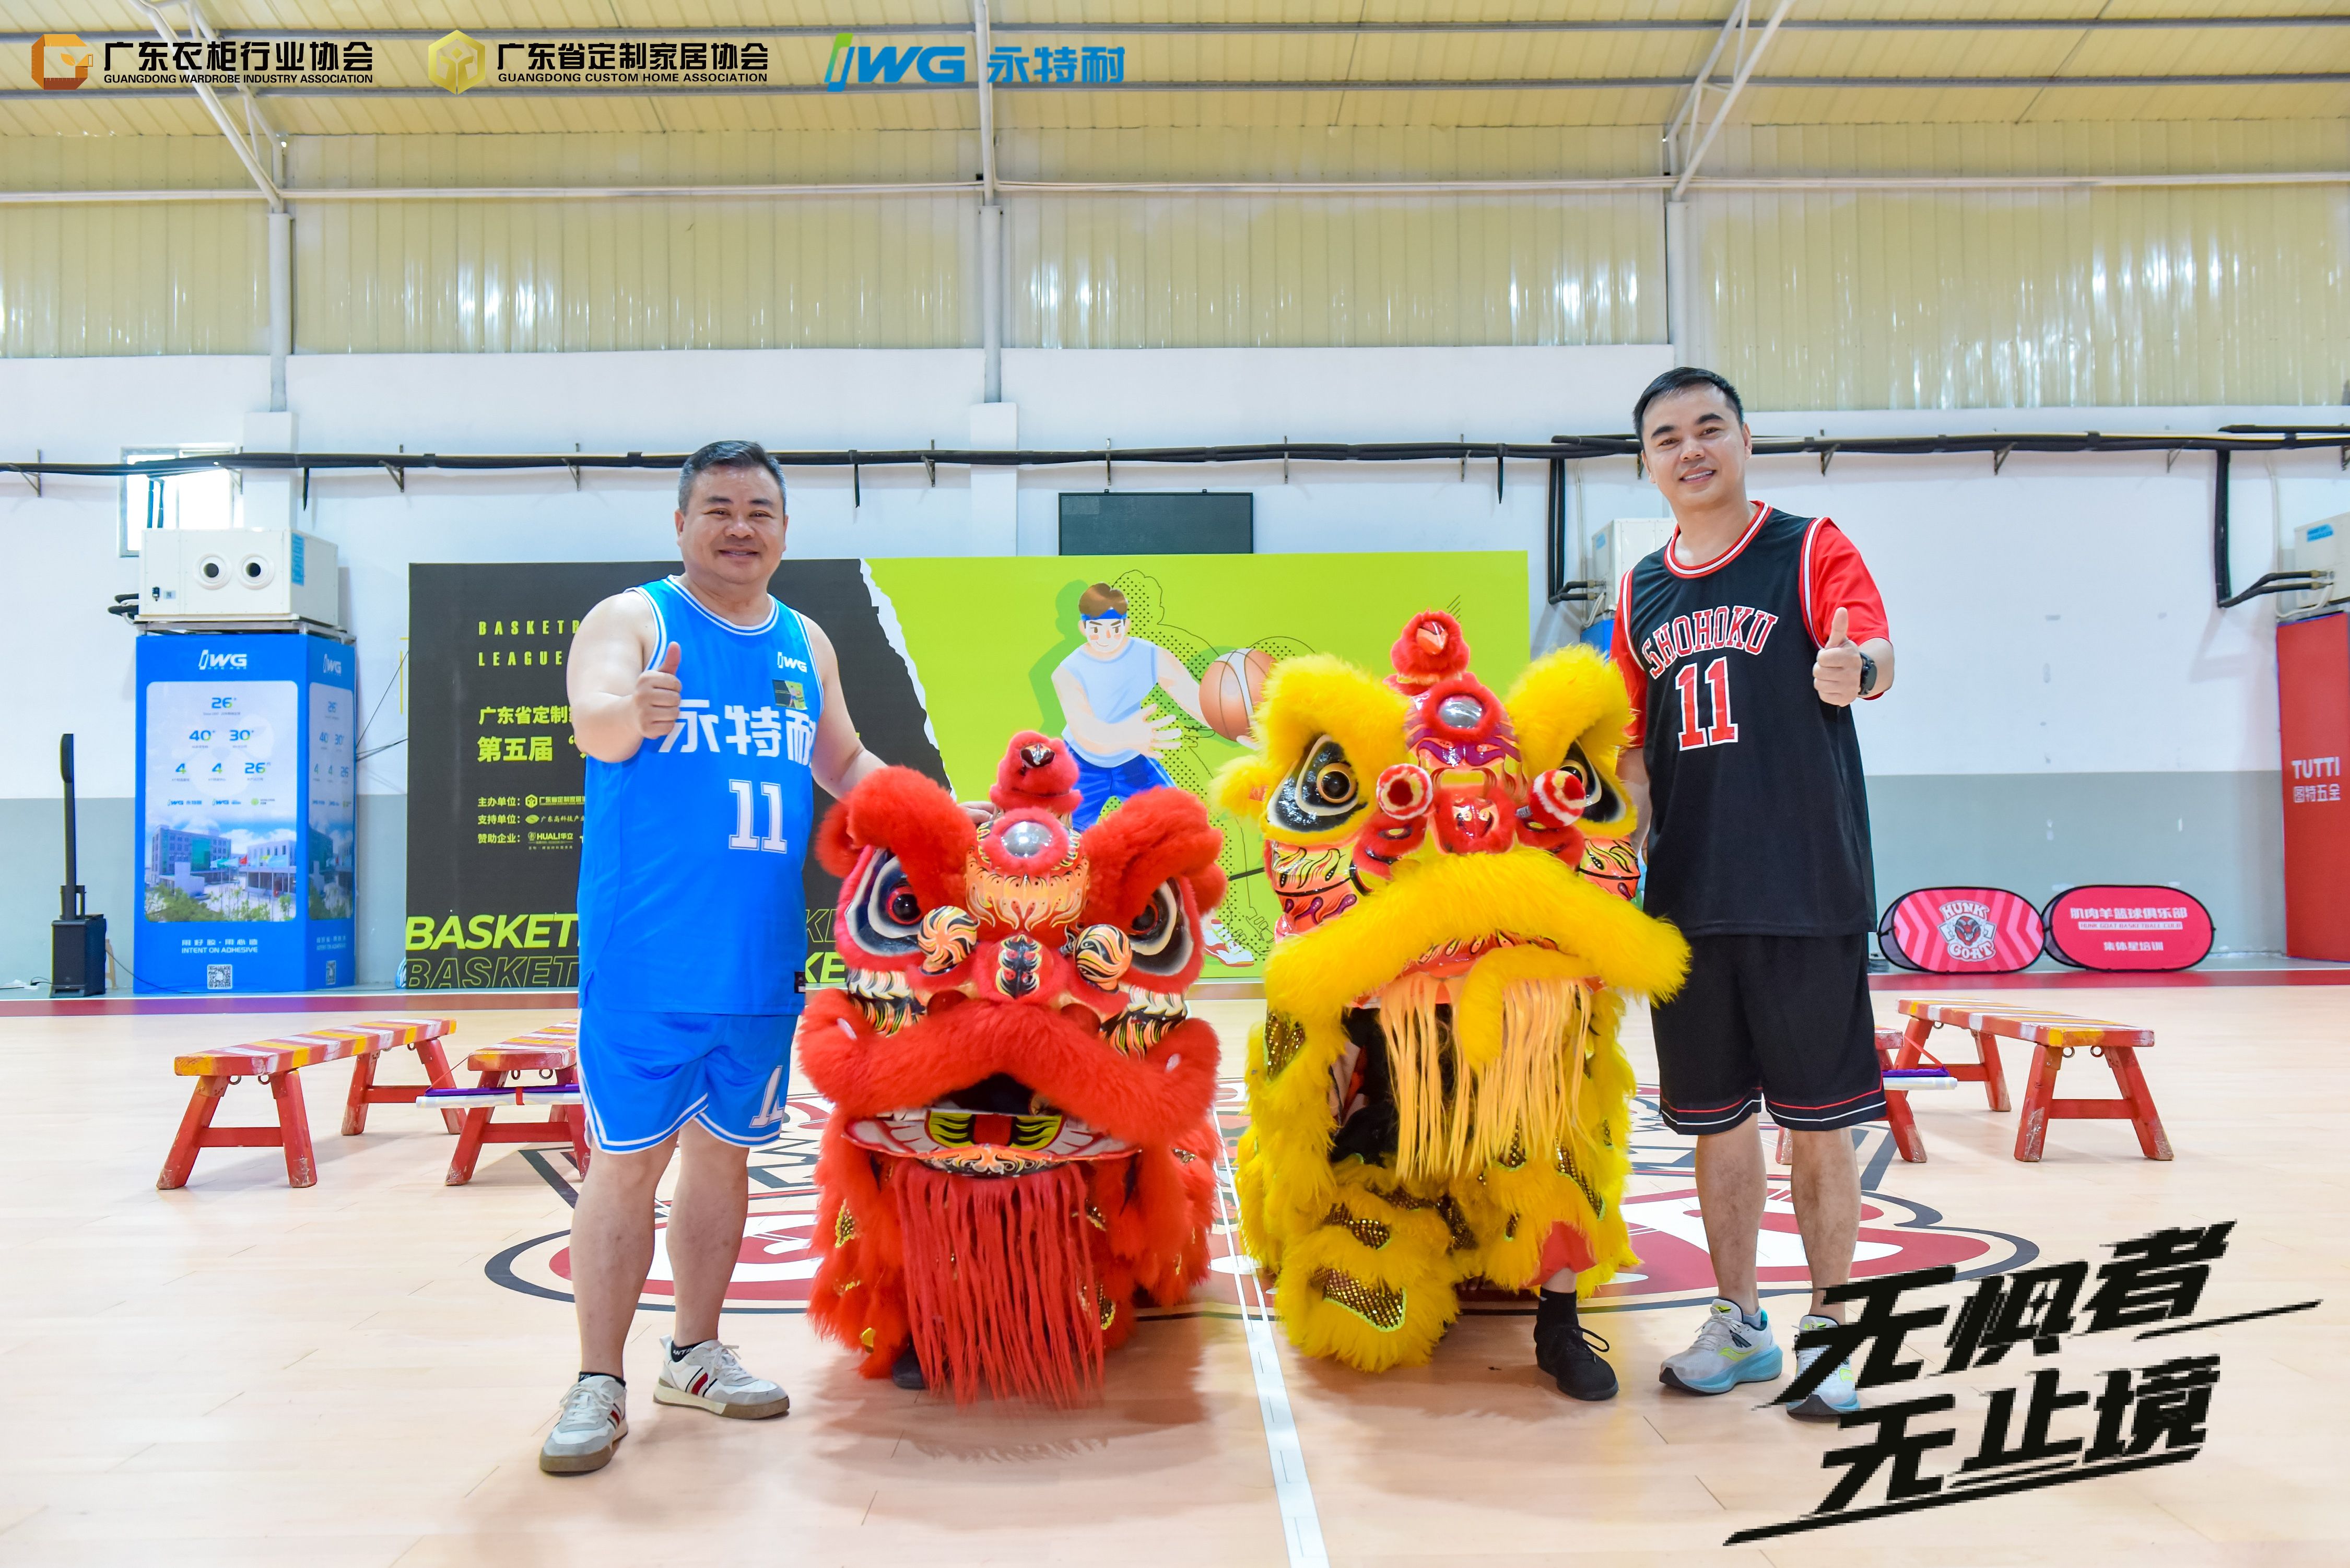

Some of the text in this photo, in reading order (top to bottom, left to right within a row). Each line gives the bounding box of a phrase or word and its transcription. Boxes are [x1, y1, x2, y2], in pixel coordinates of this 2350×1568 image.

[1642, 605, 1778, 679] SHOHOKU
[478, 651, 562, 667] LEAGUE
[1675, 656, 1738, 751] 11
[479, 705, 571, 724] 广东省定制
[2292, 756, 2340, 779] TUTTI
[478, 796, 520, 807] 主办单位：
[2294, 783, 2341, 803] 图特五金
[478, 814, 520, 824] 支持单位：
[728, 779, 787, 854] 11
[478, 833, 520, 844] 赞助企业：
[1941, 901, 1988, 920] HUNK
[2070, 907, 2188, 919] 肌肉羊篮球俱乐部
[406, 913, 579, 951] BASKET
[1949, 941, 1993, 960] GOAT
